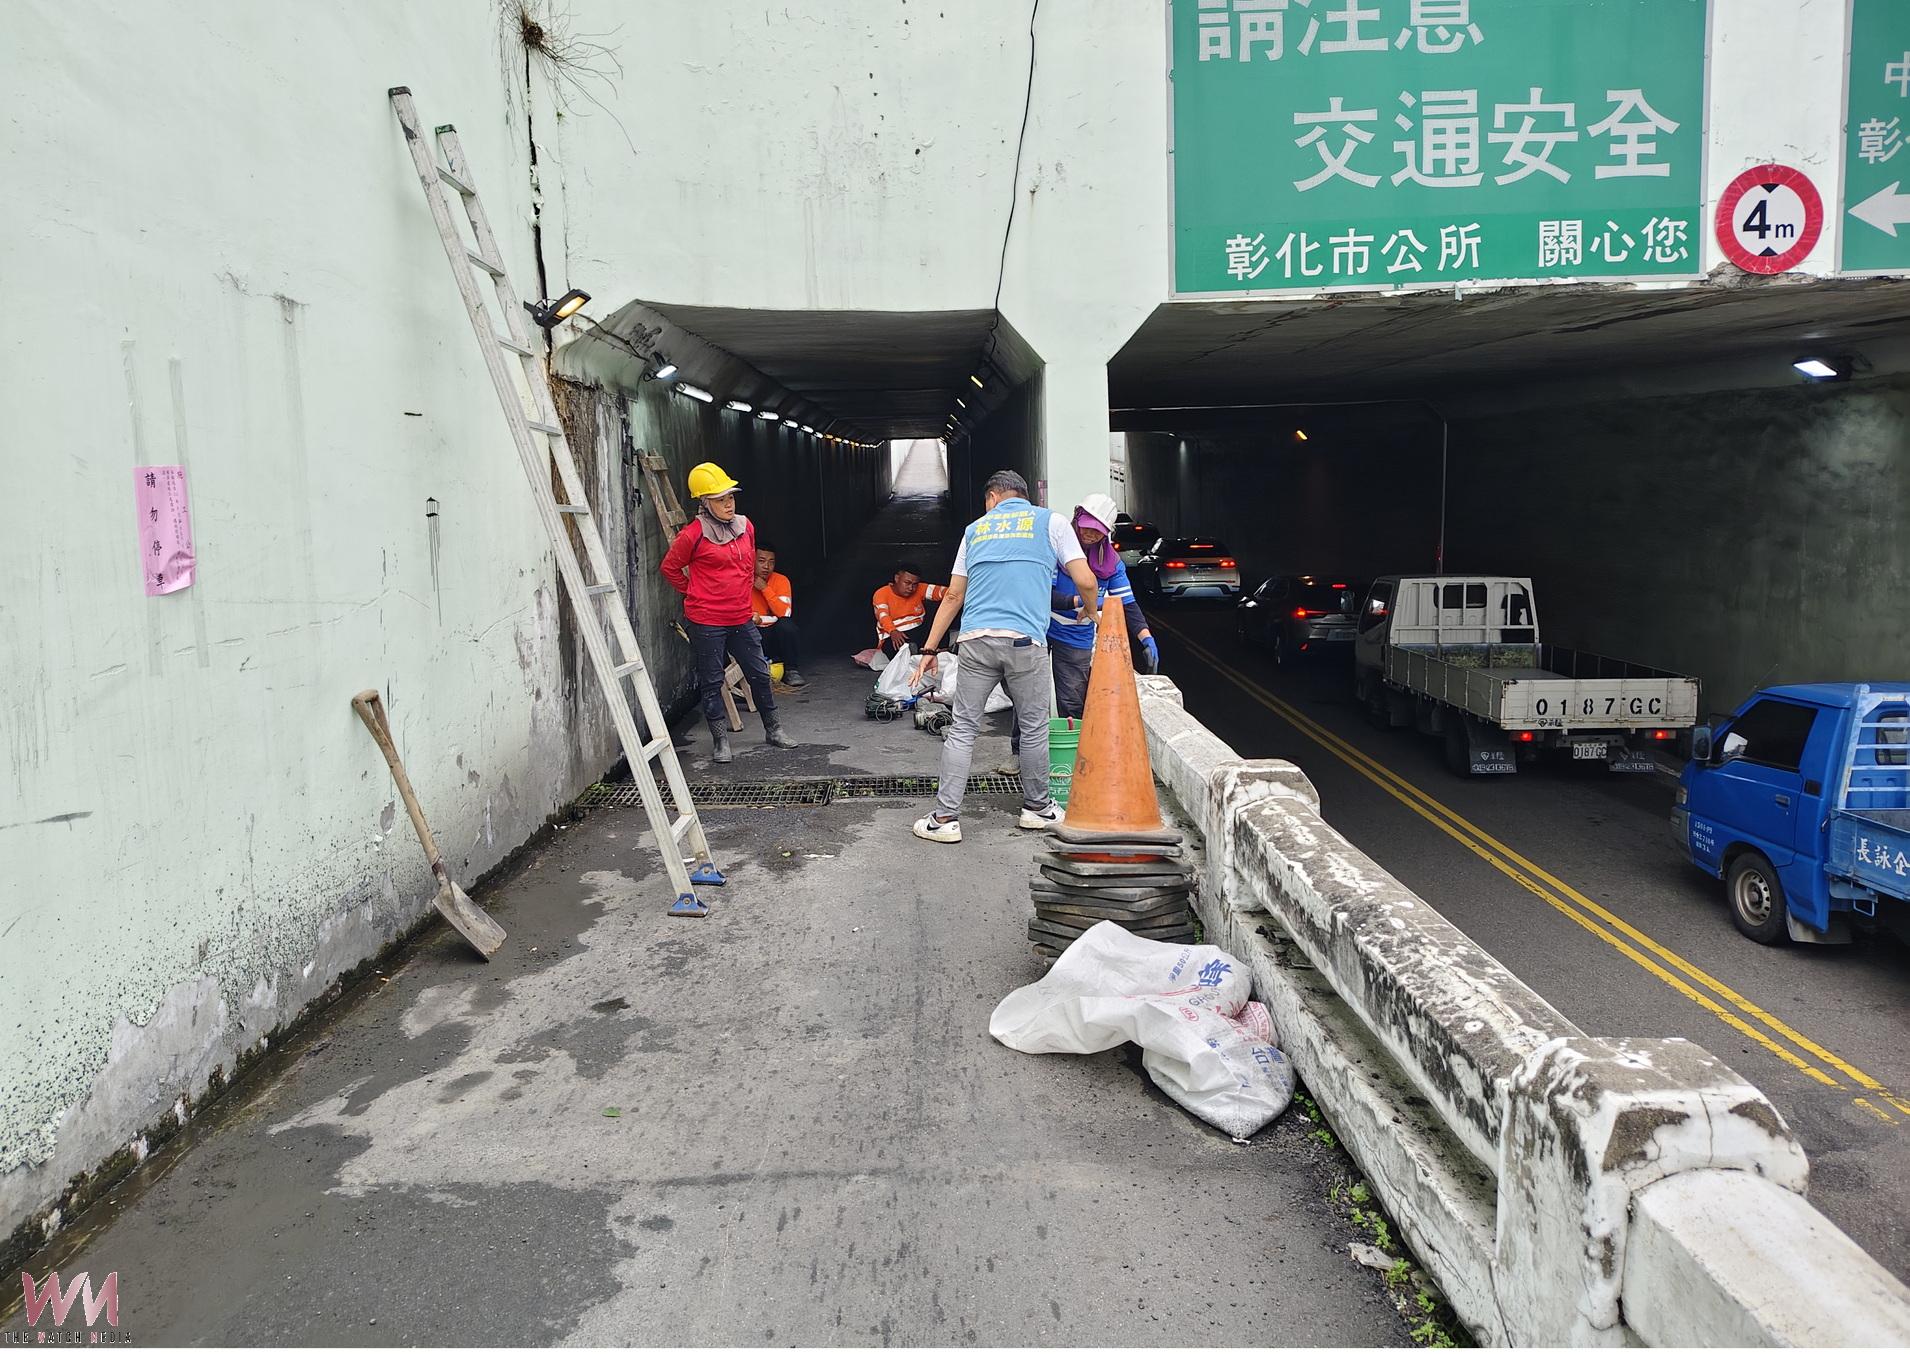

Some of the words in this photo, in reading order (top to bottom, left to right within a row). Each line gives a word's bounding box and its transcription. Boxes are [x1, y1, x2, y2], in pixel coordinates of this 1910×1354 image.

[1292, 87, 1681, 193] 交通安全
[1741, 200, 1796, 241] 4m
[1225, 222, 1483, 281] 彰化市公所
[1537, 216, 1690, 267] 關心您
[975, 518, 1034, 535] 林水源
